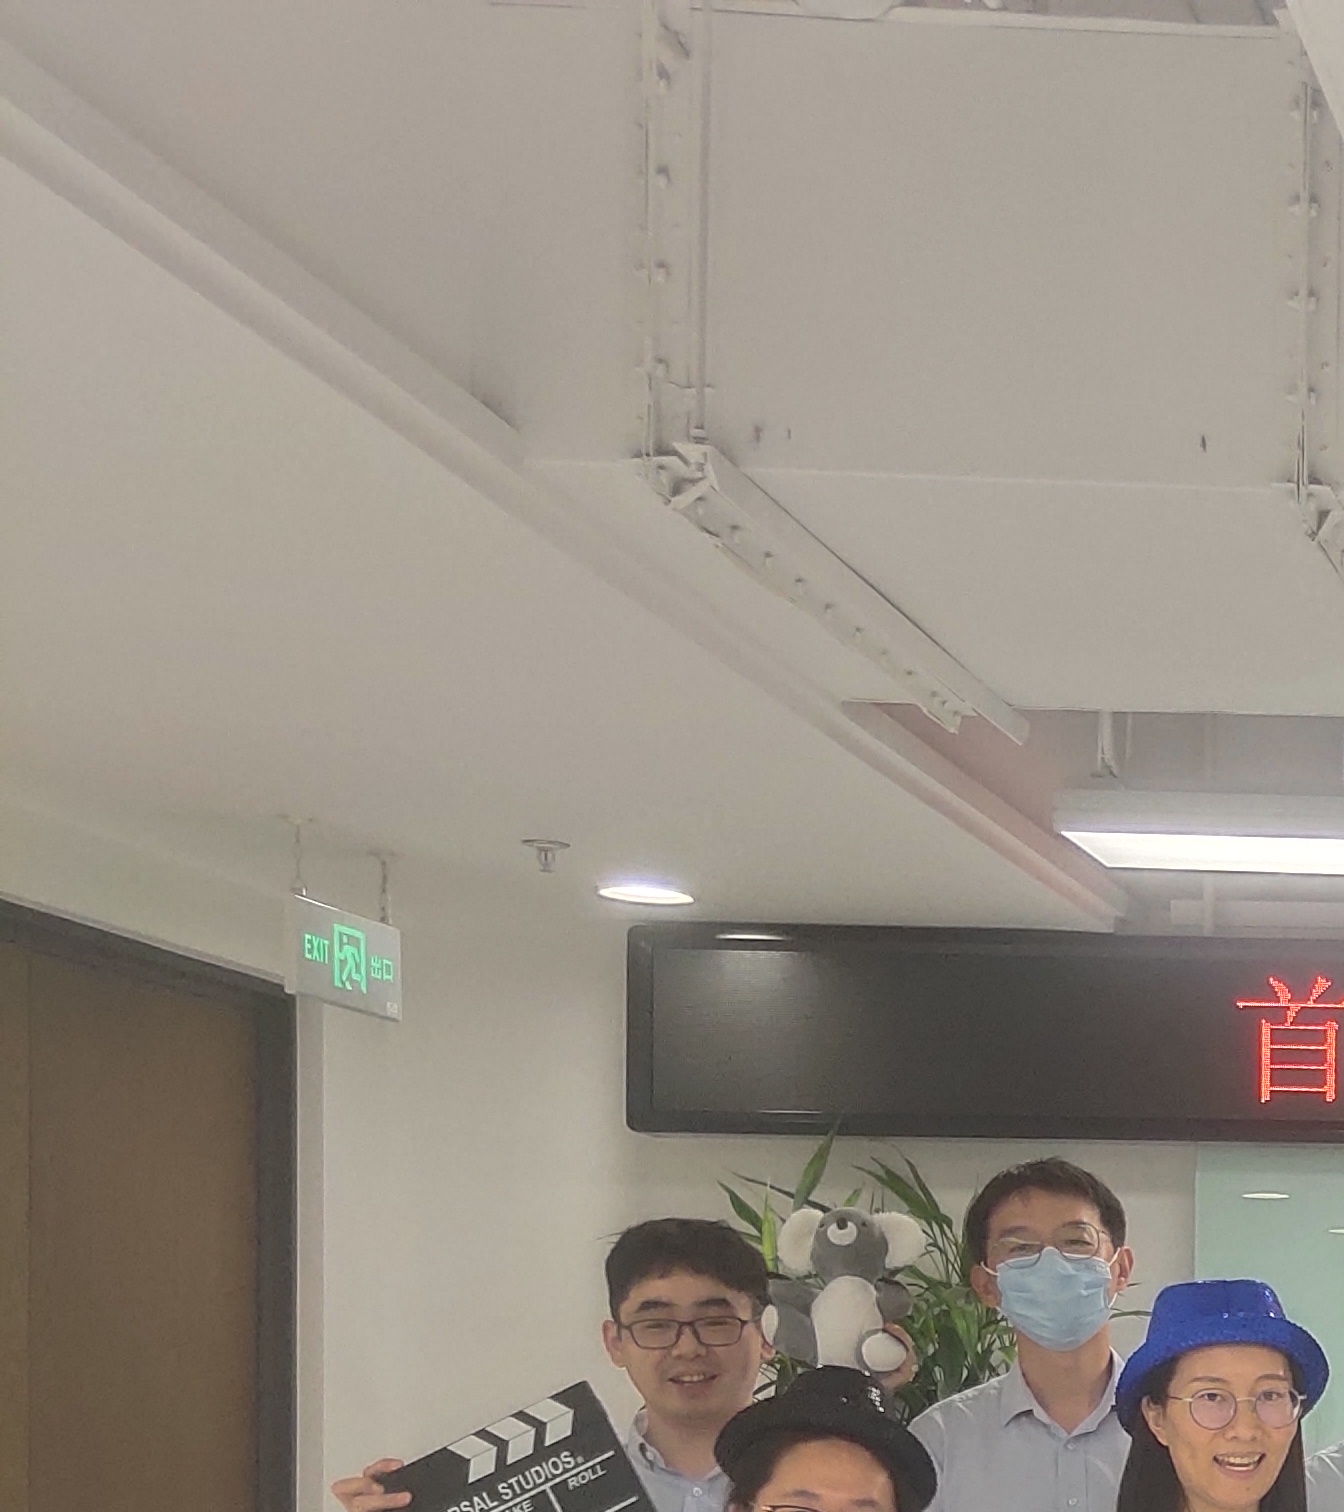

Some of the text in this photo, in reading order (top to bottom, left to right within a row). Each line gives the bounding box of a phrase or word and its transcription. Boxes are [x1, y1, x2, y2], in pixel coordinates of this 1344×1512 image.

[304, 934, 329, 964] EXIT
[371, 955, 394, 982] 出口
[498, 1451, 576, 1500] STUDIOS
[567, 1465, 607, 1490] ROLL
